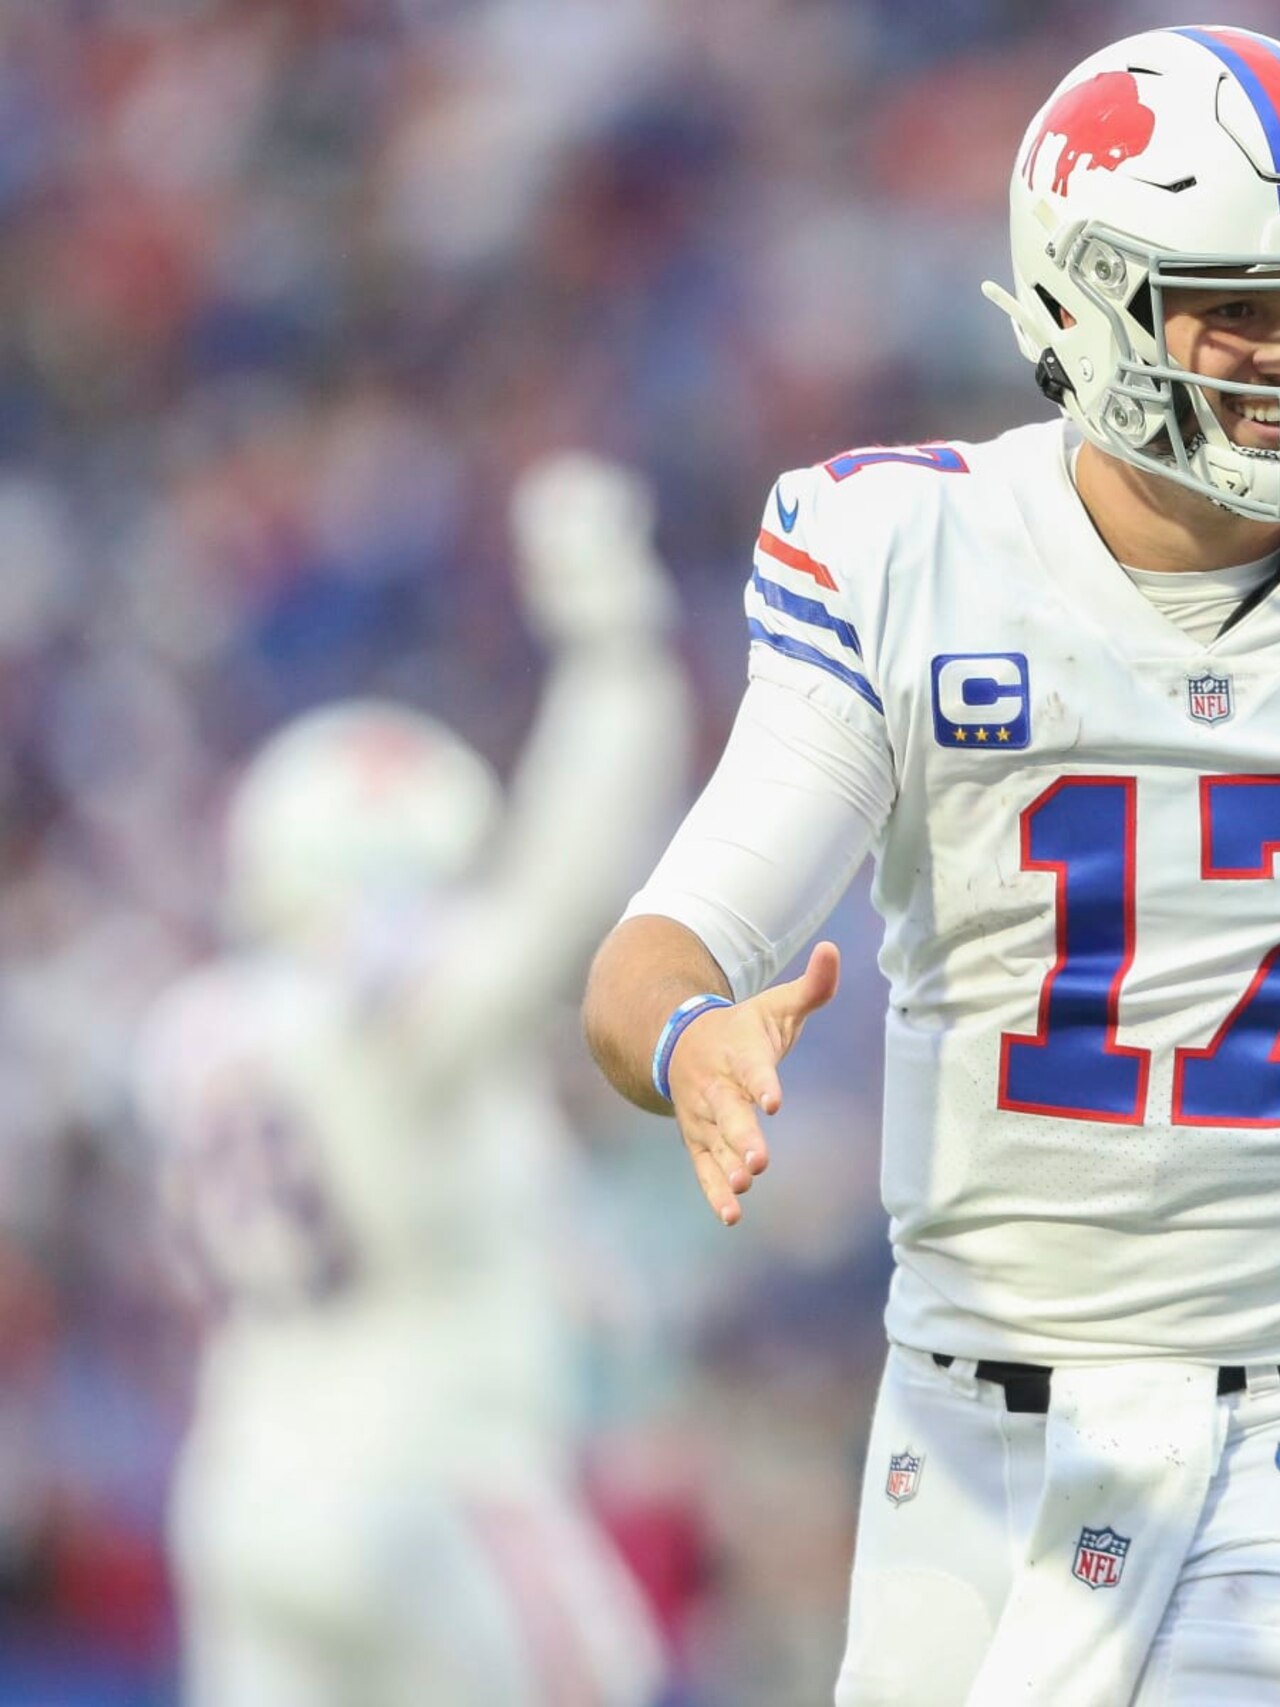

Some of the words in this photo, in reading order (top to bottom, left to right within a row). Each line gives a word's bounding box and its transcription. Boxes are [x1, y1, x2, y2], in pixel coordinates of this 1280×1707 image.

[938, 658, 1022, 725] C
[1192, 694, 1227, 718] NFL
[1076, 1549, 1118, 1584] NFL
